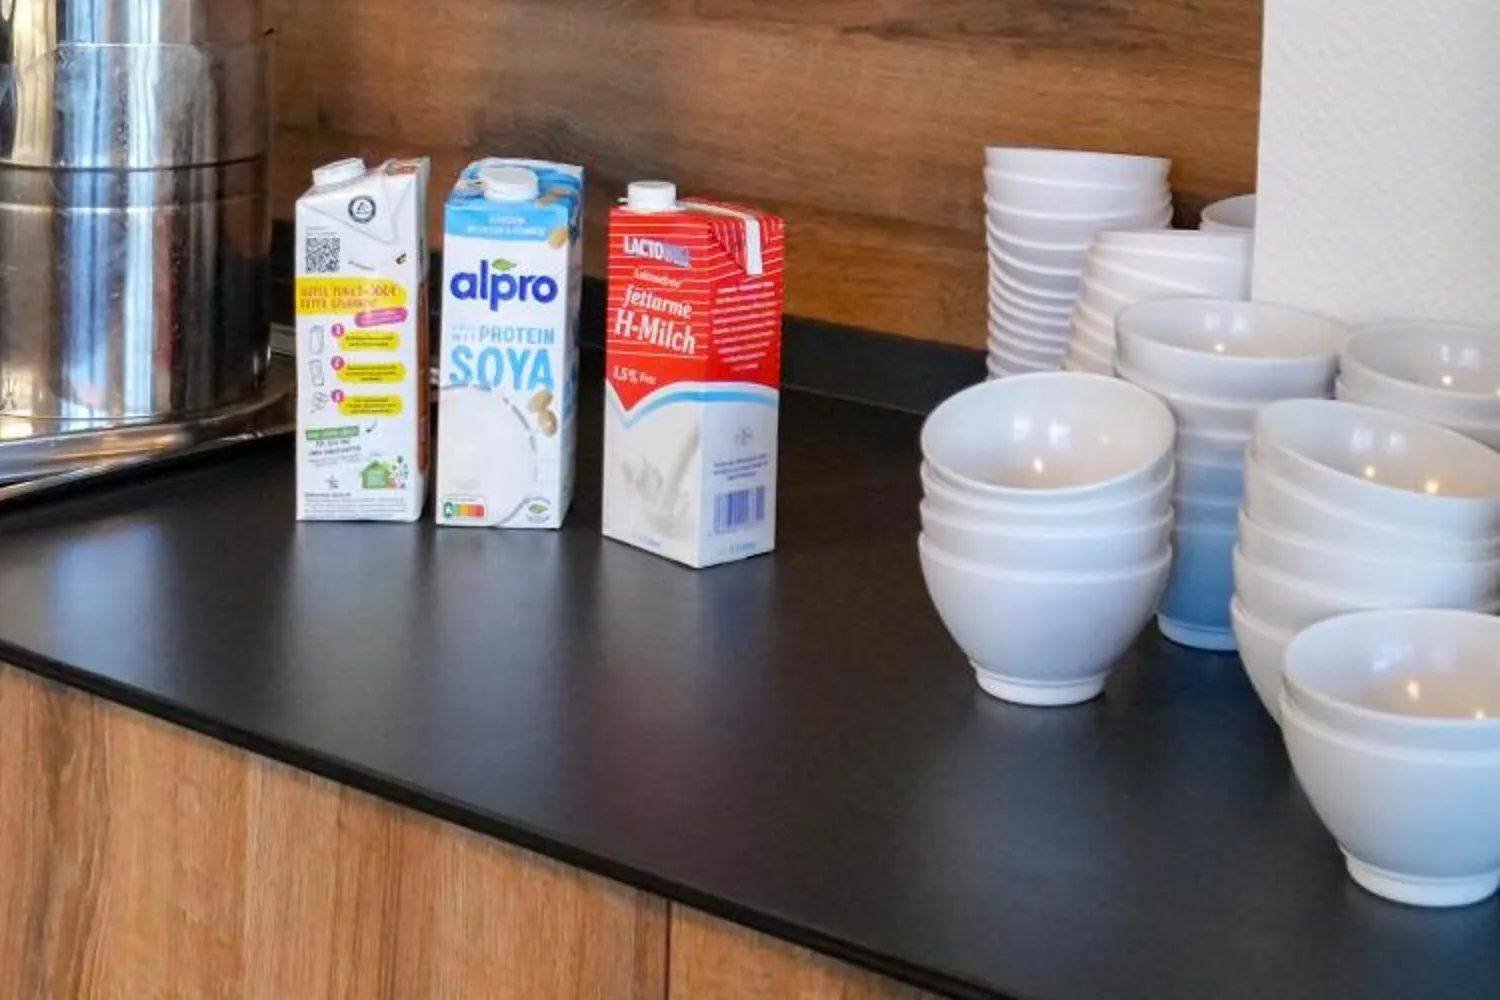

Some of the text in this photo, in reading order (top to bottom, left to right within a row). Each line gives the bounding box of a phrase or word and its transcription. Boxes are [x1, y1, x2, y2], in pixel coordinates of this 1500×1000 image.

[449, 259, 559, 312] alpro
[478, 324, 555, 345] PROTEIN
[614, 308, 696, 355] H-Milch
[449, 344, 555, 392] SOYA
